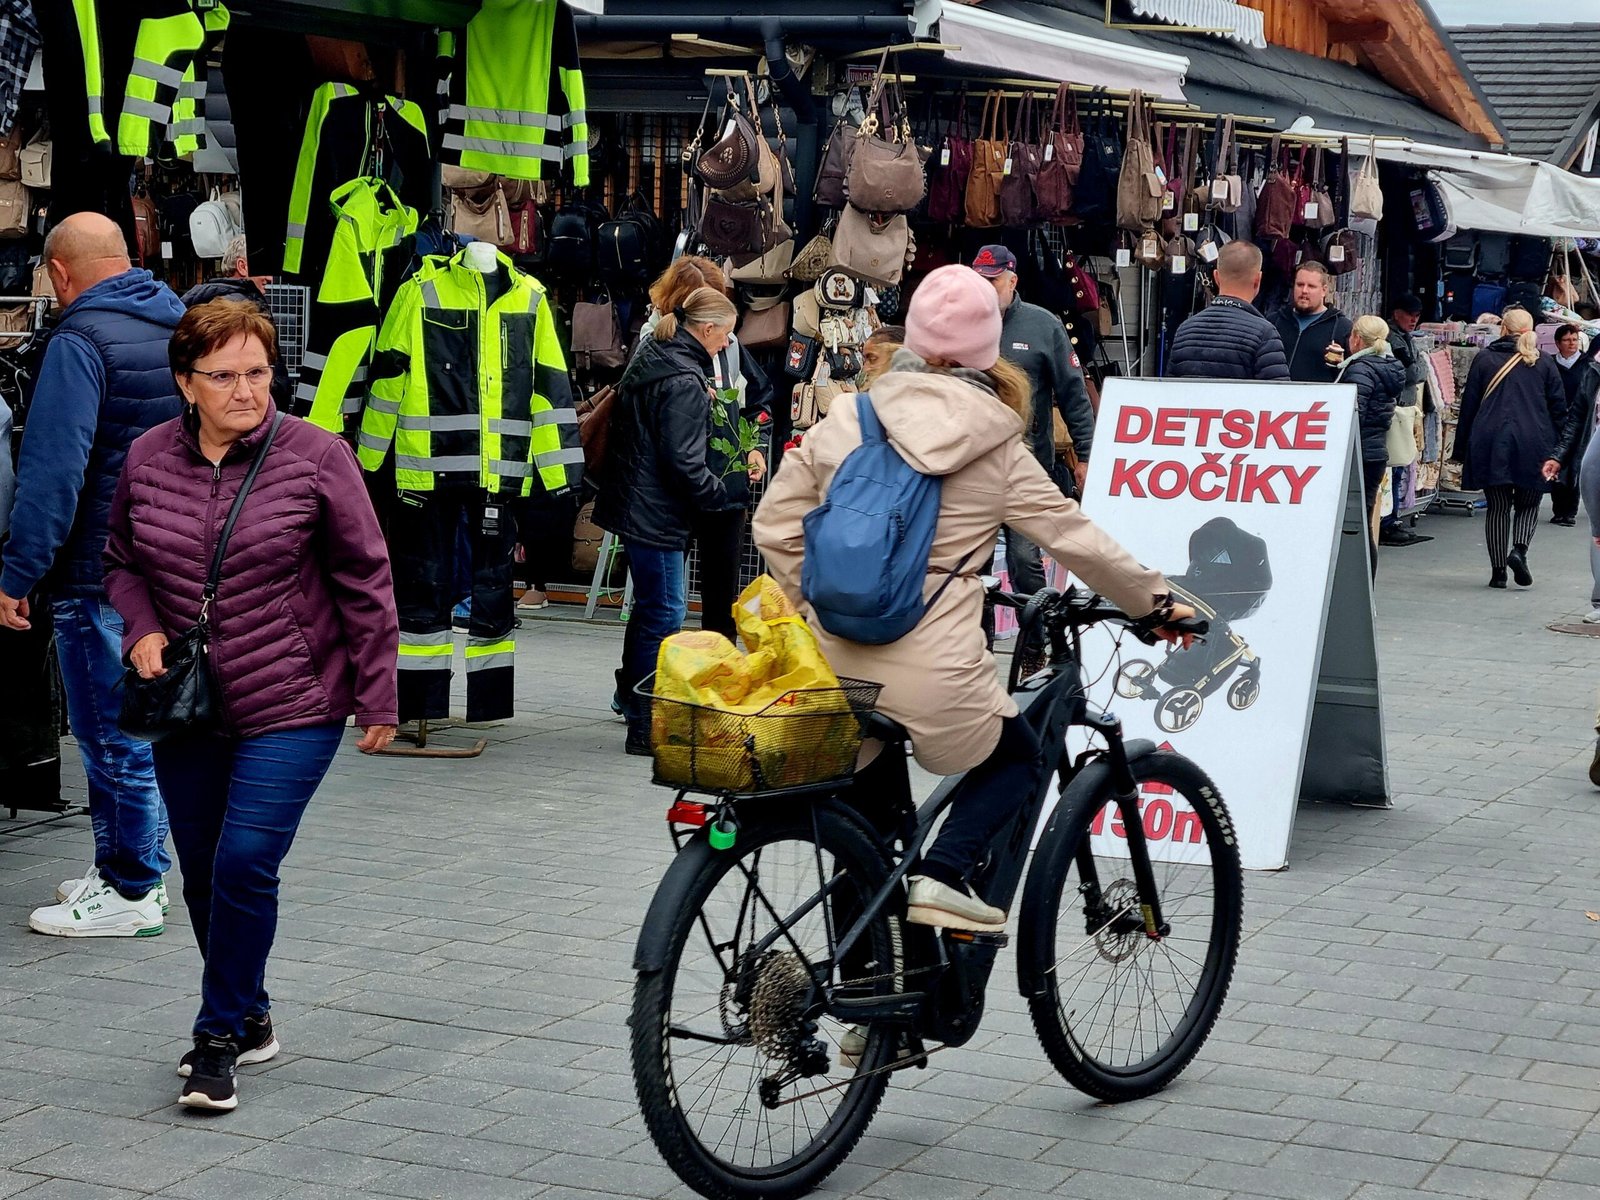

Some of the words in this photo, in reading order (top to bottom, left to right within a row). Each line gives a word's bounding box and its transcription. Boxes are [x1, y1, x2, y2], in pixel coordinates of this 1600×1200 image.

[1114, 401, 1331, 451] DETSKÉ
[1108, 452, 1322, 504] KOČÍKY
[1198, 785, 1235, 846] MAXXIS
[87, 902, 103, 912] FILA
